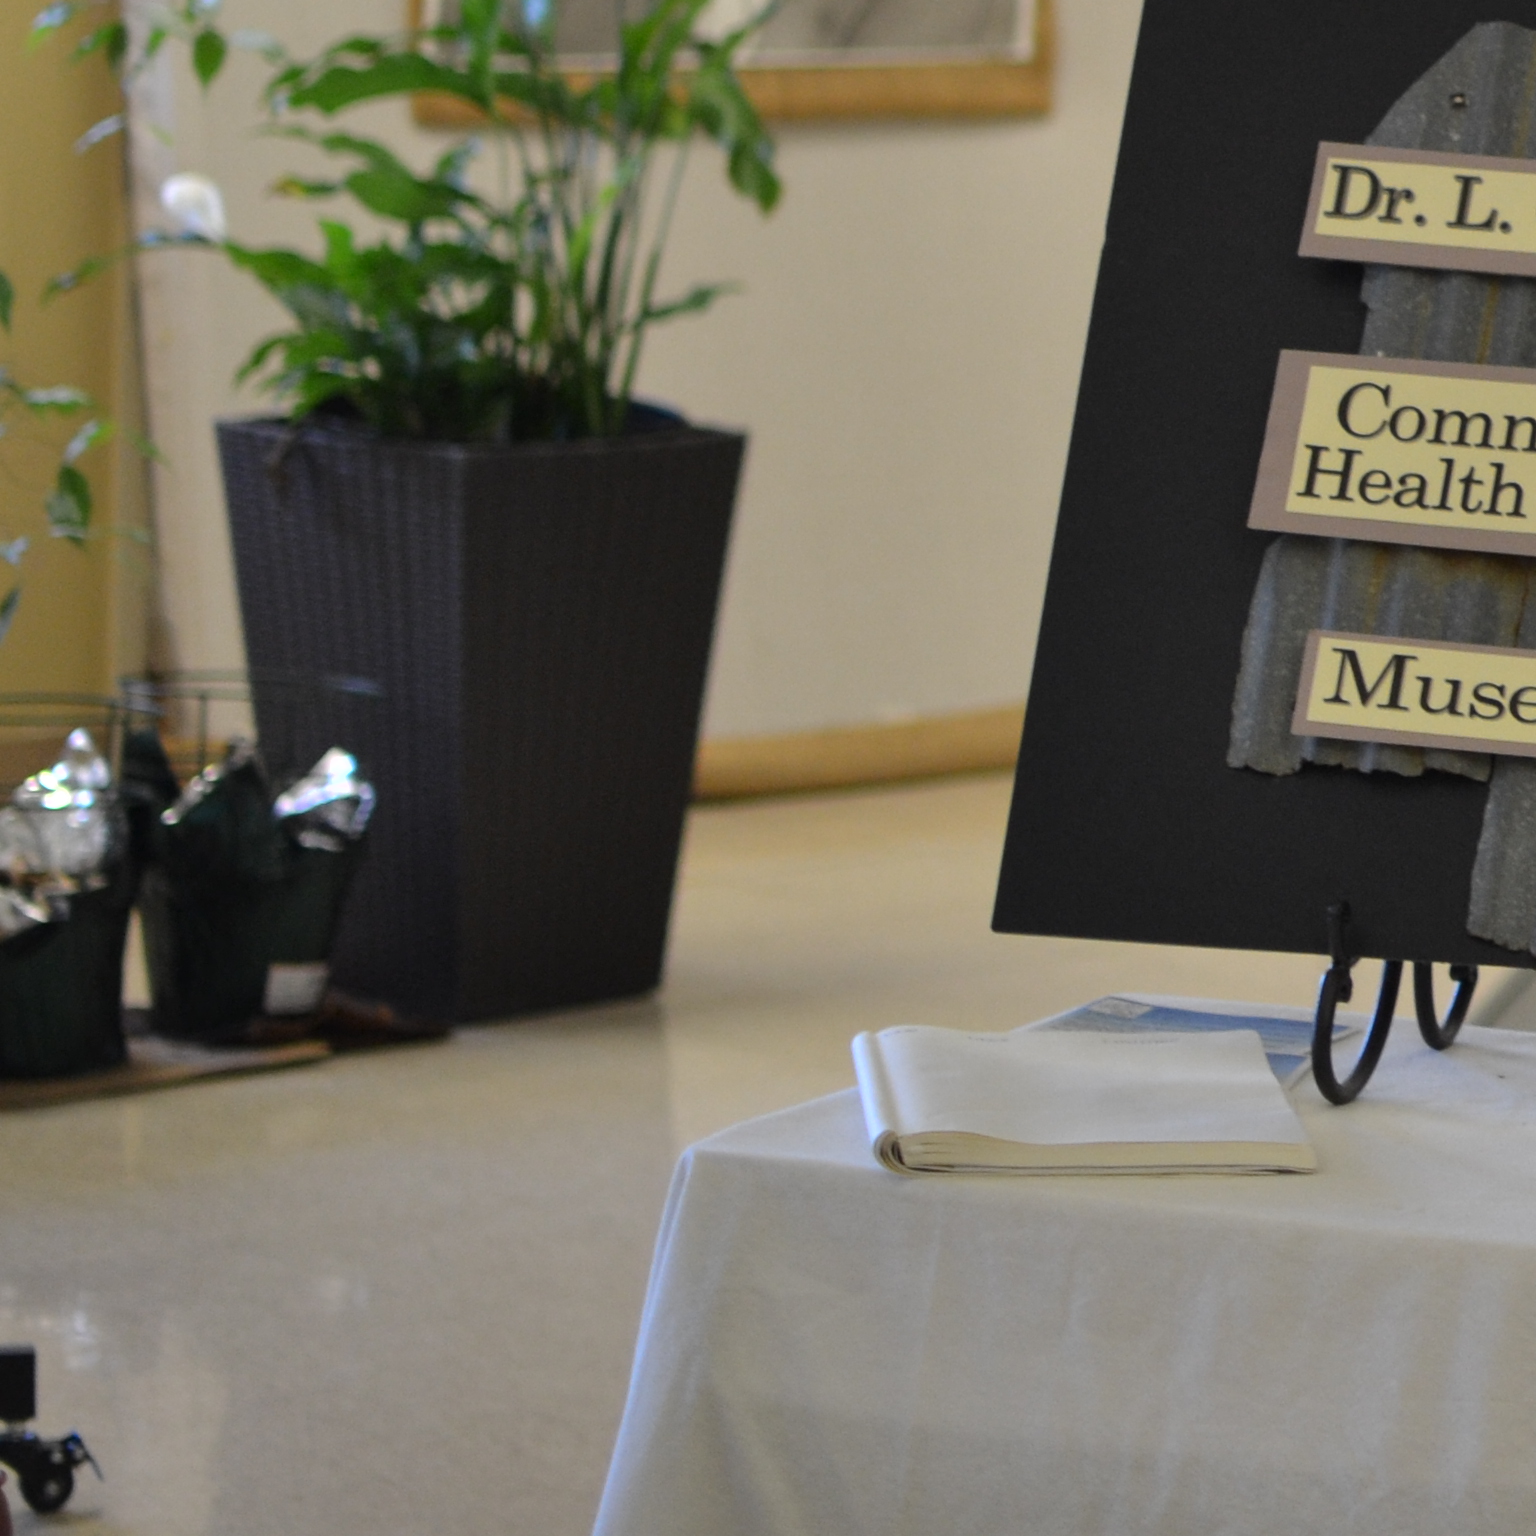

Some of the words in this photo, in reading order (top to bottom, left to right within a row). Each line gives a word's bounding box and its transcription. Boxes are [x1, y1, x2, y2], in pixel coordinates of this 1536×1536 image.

[1323, 163, 1427, 226] Dr.
[1446, 174, 1512, 233] L.
[1296, 444, 1527, 518] Health
